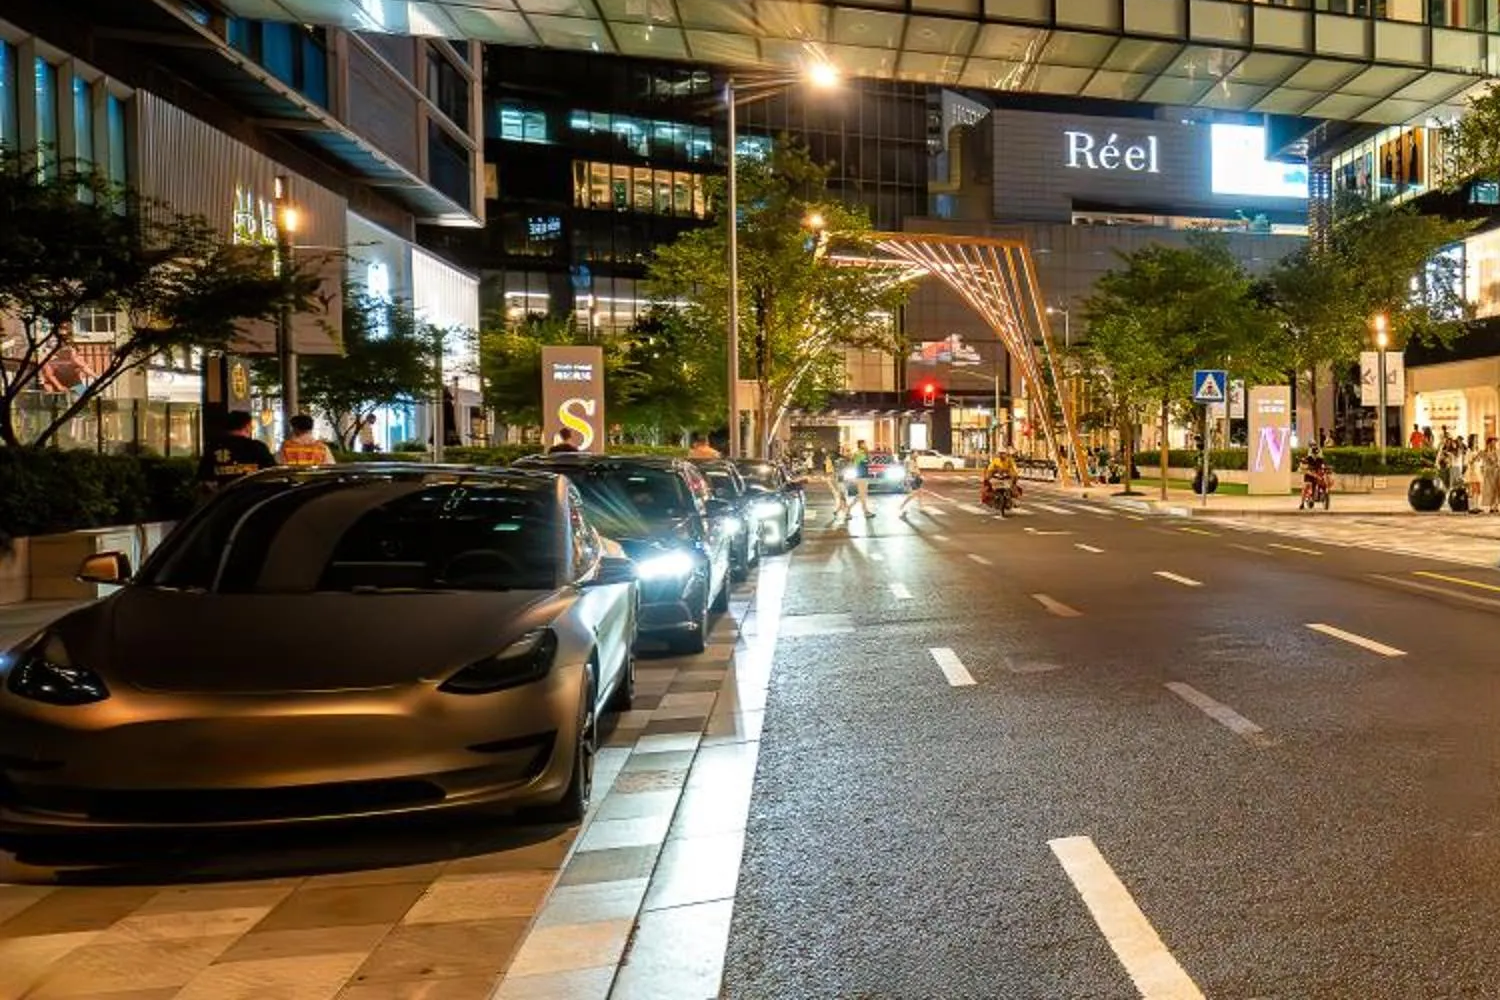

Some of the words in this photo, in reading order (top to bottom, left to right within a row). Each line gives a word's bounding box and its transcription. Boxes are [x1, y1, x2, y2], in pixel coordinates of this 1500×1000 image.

[1064, 131, 1160, 173] Réel
[553, 398, 596, 451] S
[1250, 427, 1290, 473] N
